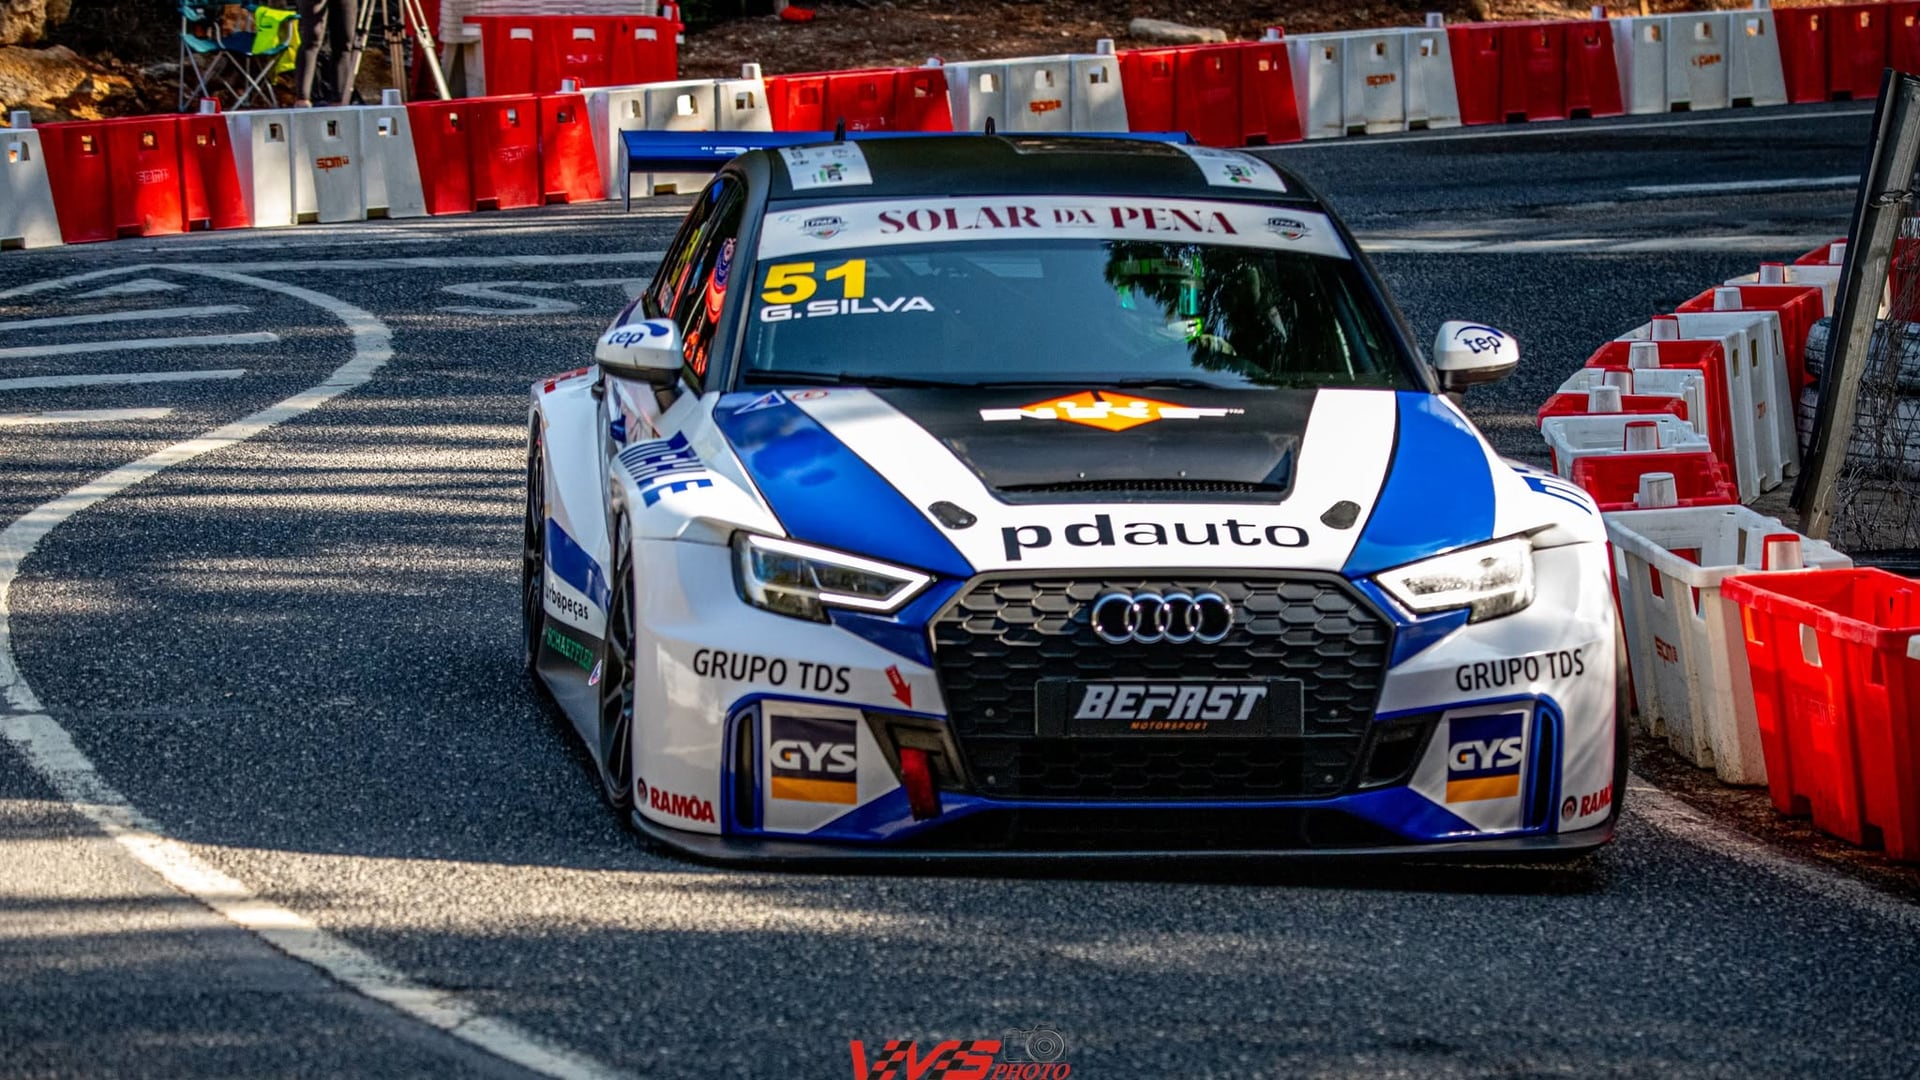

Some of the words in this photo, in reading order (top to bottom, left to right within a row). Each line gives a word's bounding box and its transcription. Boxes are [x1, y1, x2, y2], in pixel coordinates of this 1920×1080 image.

[878, 206, 1042, 234] SOLAR
[1054, 208, 1095, 224] DA
[1109, 206, 1238, 235] PENA
[761, 258, 867, 304] 51
[1463, 336, 1502, 354] tep
[1001, 514, 1310, 561] pdauto
[693, 649, 788, 686] GRUPO
[798, 660, 851, 694] TDS
[1456, 655, 1540, 691] GRUPO
[1546, 648, 1585, 680] TDS
[1073, 684, 1268, 720] BEFAST
[1130, 721, 1209, 731] MOTORSPORT
[770, 739, 858, 774] GYS
[1448, 736, 1523, 772] GYS
